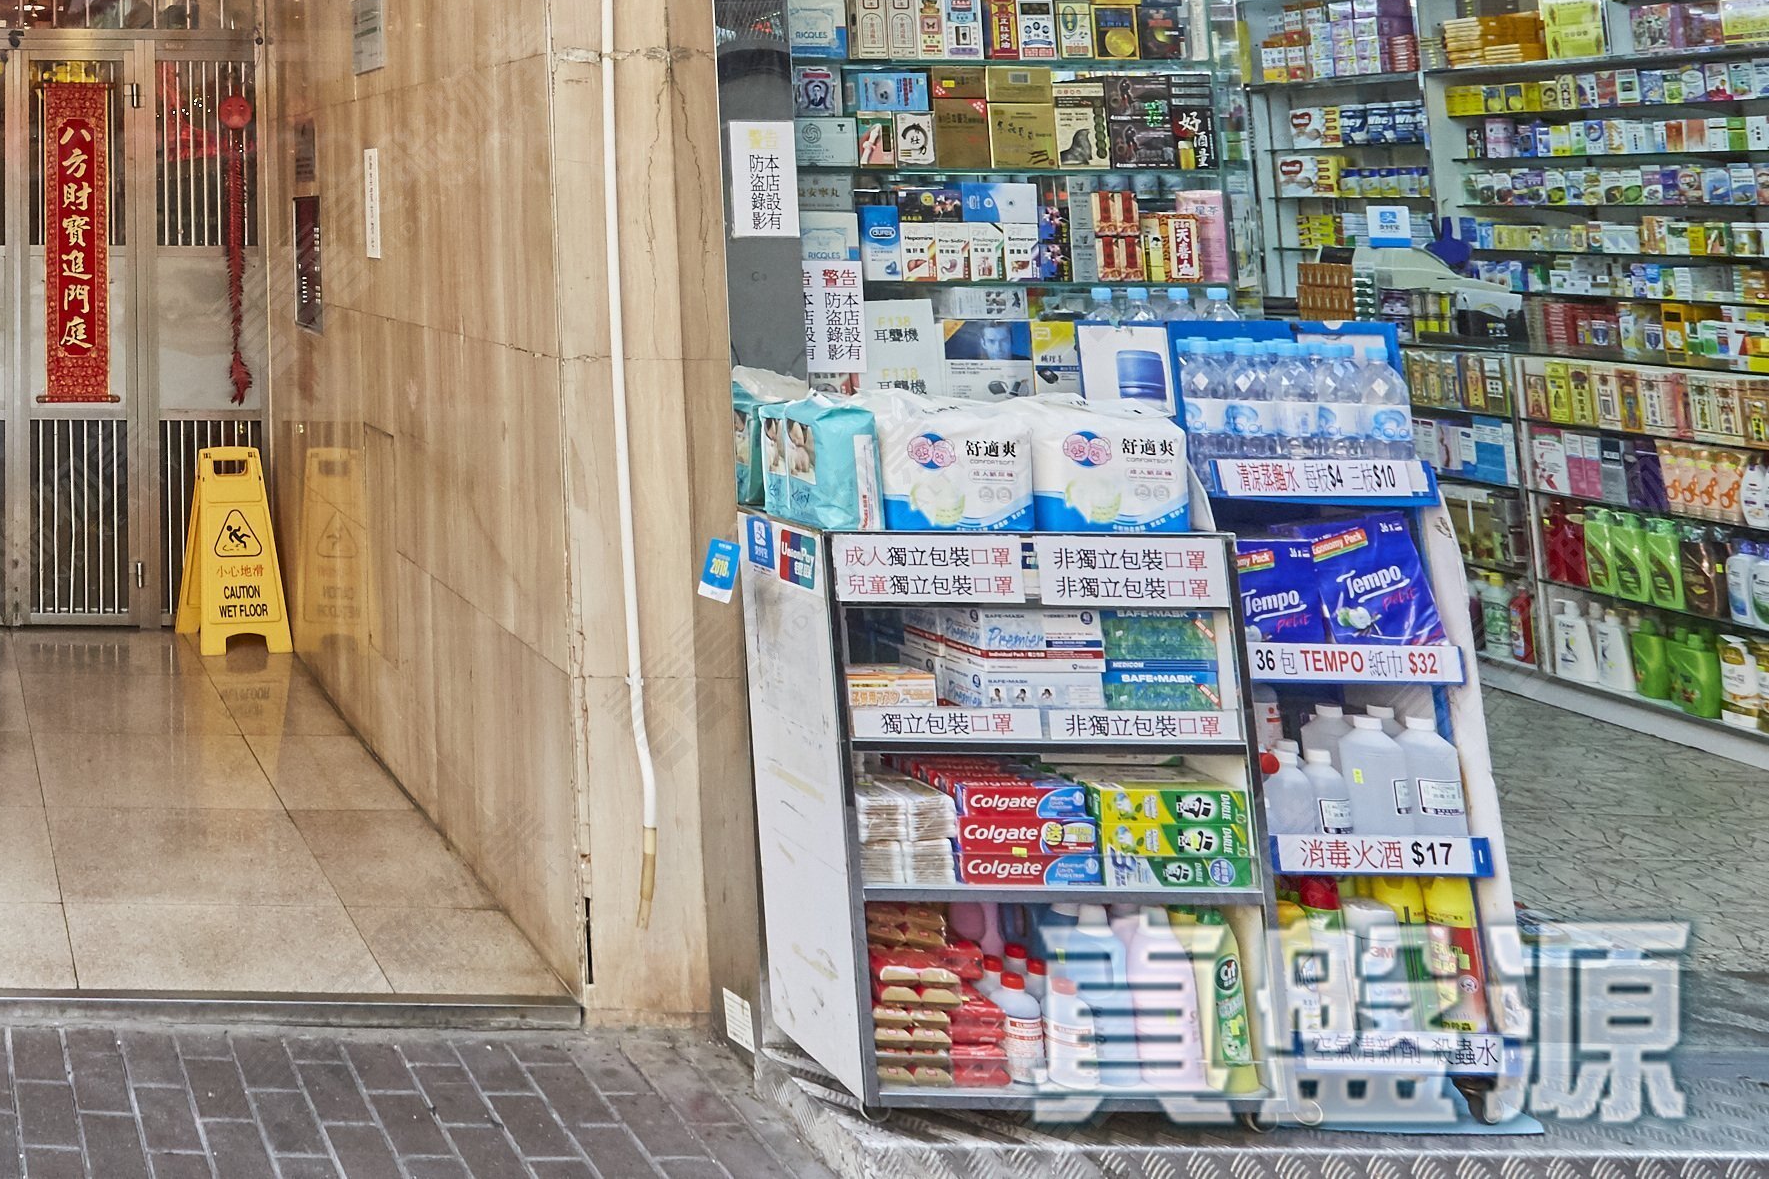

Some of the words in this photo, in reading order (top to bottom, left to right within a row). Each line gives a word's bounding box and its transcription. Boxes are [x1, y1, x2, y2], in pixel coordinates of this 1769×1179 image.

[765, 154, 783, 230] 本店設有
[59, 125, 95, 350] 八方財寶進門庭
[870, 228, 895, 238] durex
[822, 268, 859, 287] 警告
[842, 291, 862, 361] 本店設有
[965, 440, 1017, 459] 舒適爽
[1121, 438, 1175, 457] 舒適爽
[1304, 462, 1344, 492] 每枝$4
[1348, 463, 1396, 493] 三枝$10
[1344, 531, 1363, 545] Pack
[781, 541, 814, 566] UnionPay
[845, 546, 1012, 568] 成人獨立包裝口罩
[1054, 548, 1208, 572] 非獨立包裝口罩
[216, 564, 265, 579] 小心地滑
[1335, 565, 1402, 600] Tempo
[223, 585, 261, 601] CAUTION
[848, 575, 1015, 597] 兒童獨立包裝口罩
[1056, 577, 1212, 601] 非獨立包裝口罩
[219, 604, 238, 619] WET
[239, 602, 269, 618] FLOOR
[1241, 589, 1300, 617] Tempo
[987, 628, 1045, 649] Premier
[1255, 649, 1276, 671] 36
[1280, 648, 1298, 675] 包
[1300, 649, 1364, 673] TEMPO
[1368, 650, 1403, 678] 紙巾
[1408, 652, 1438, 675] $32
[881, 713, 1014, 736] 獨立包裝口罩
[1065, 714, 1222, 738] 非獨立包裝口罩
[970, 794, 1038, 811] Colgate
[1220, 793, 1232, 821] DARLIE
[964, 824, 1039, 844] Colgate
[1222, 827, 1233, 854] DARLIE
[1300, 839, 1404, 869] 消毒火酒
[1411, 841, 1453, 866] $17
[967, 859, 1043, 879] Colgate
[1370, 946, 1394, 958] 3M
[1432, 1037, 1499, 1066] 殺蟲水
